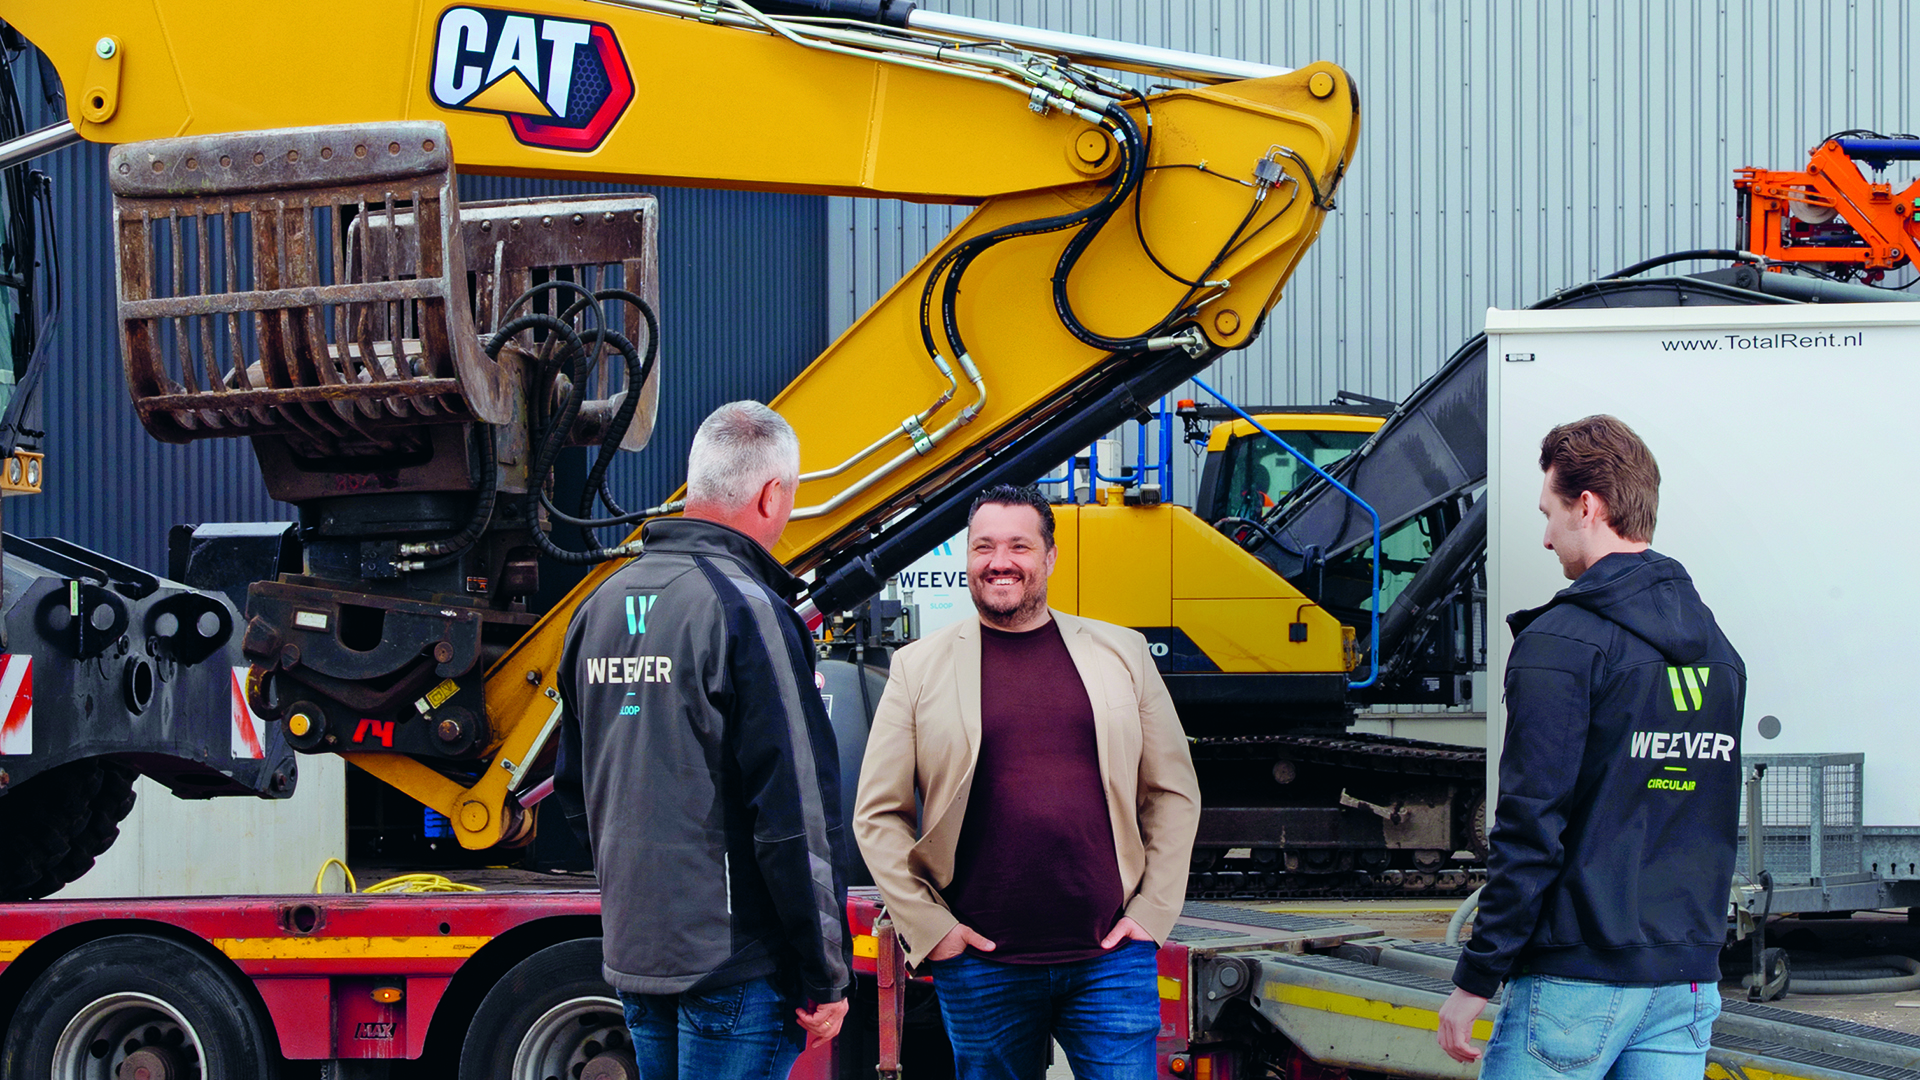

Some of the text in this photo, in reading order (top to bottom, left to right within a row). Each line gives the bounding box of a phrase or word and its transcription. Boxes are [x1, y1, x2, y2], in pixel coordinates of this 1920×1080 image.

[434, 8, 590, 118] CAT
[1661, 332, 1863, 351] www.TotalRent.nl
[900, 572, 968, 588] WEEVE
[587, 656, 672, 684] WEEVER
[620, 706, 640, 715] LOOP
[1631, 732, 1735, 762] WEEVER
[1647, 779, 1696, 790] CIRCULAIR
